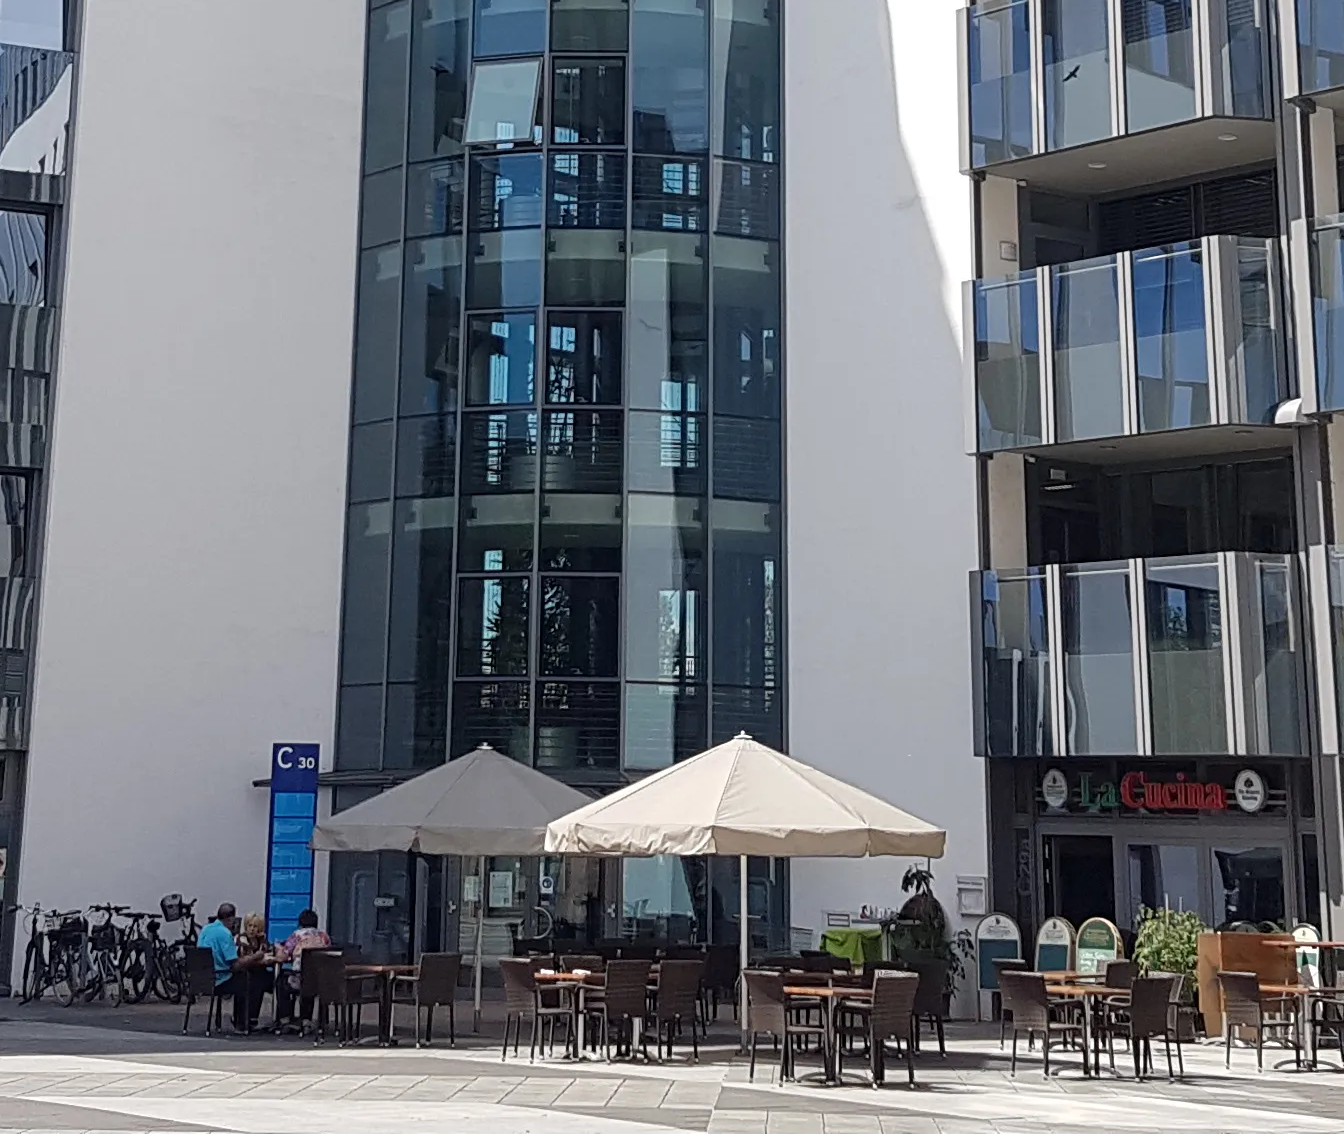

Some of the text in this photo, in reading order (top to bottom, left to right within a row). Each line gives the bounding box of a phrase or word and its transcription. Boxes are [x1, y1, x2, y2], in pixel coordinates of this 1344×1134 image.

[277, 746, 316, 769] C 30
[1077, 770, 1229, 809] La Cucina
